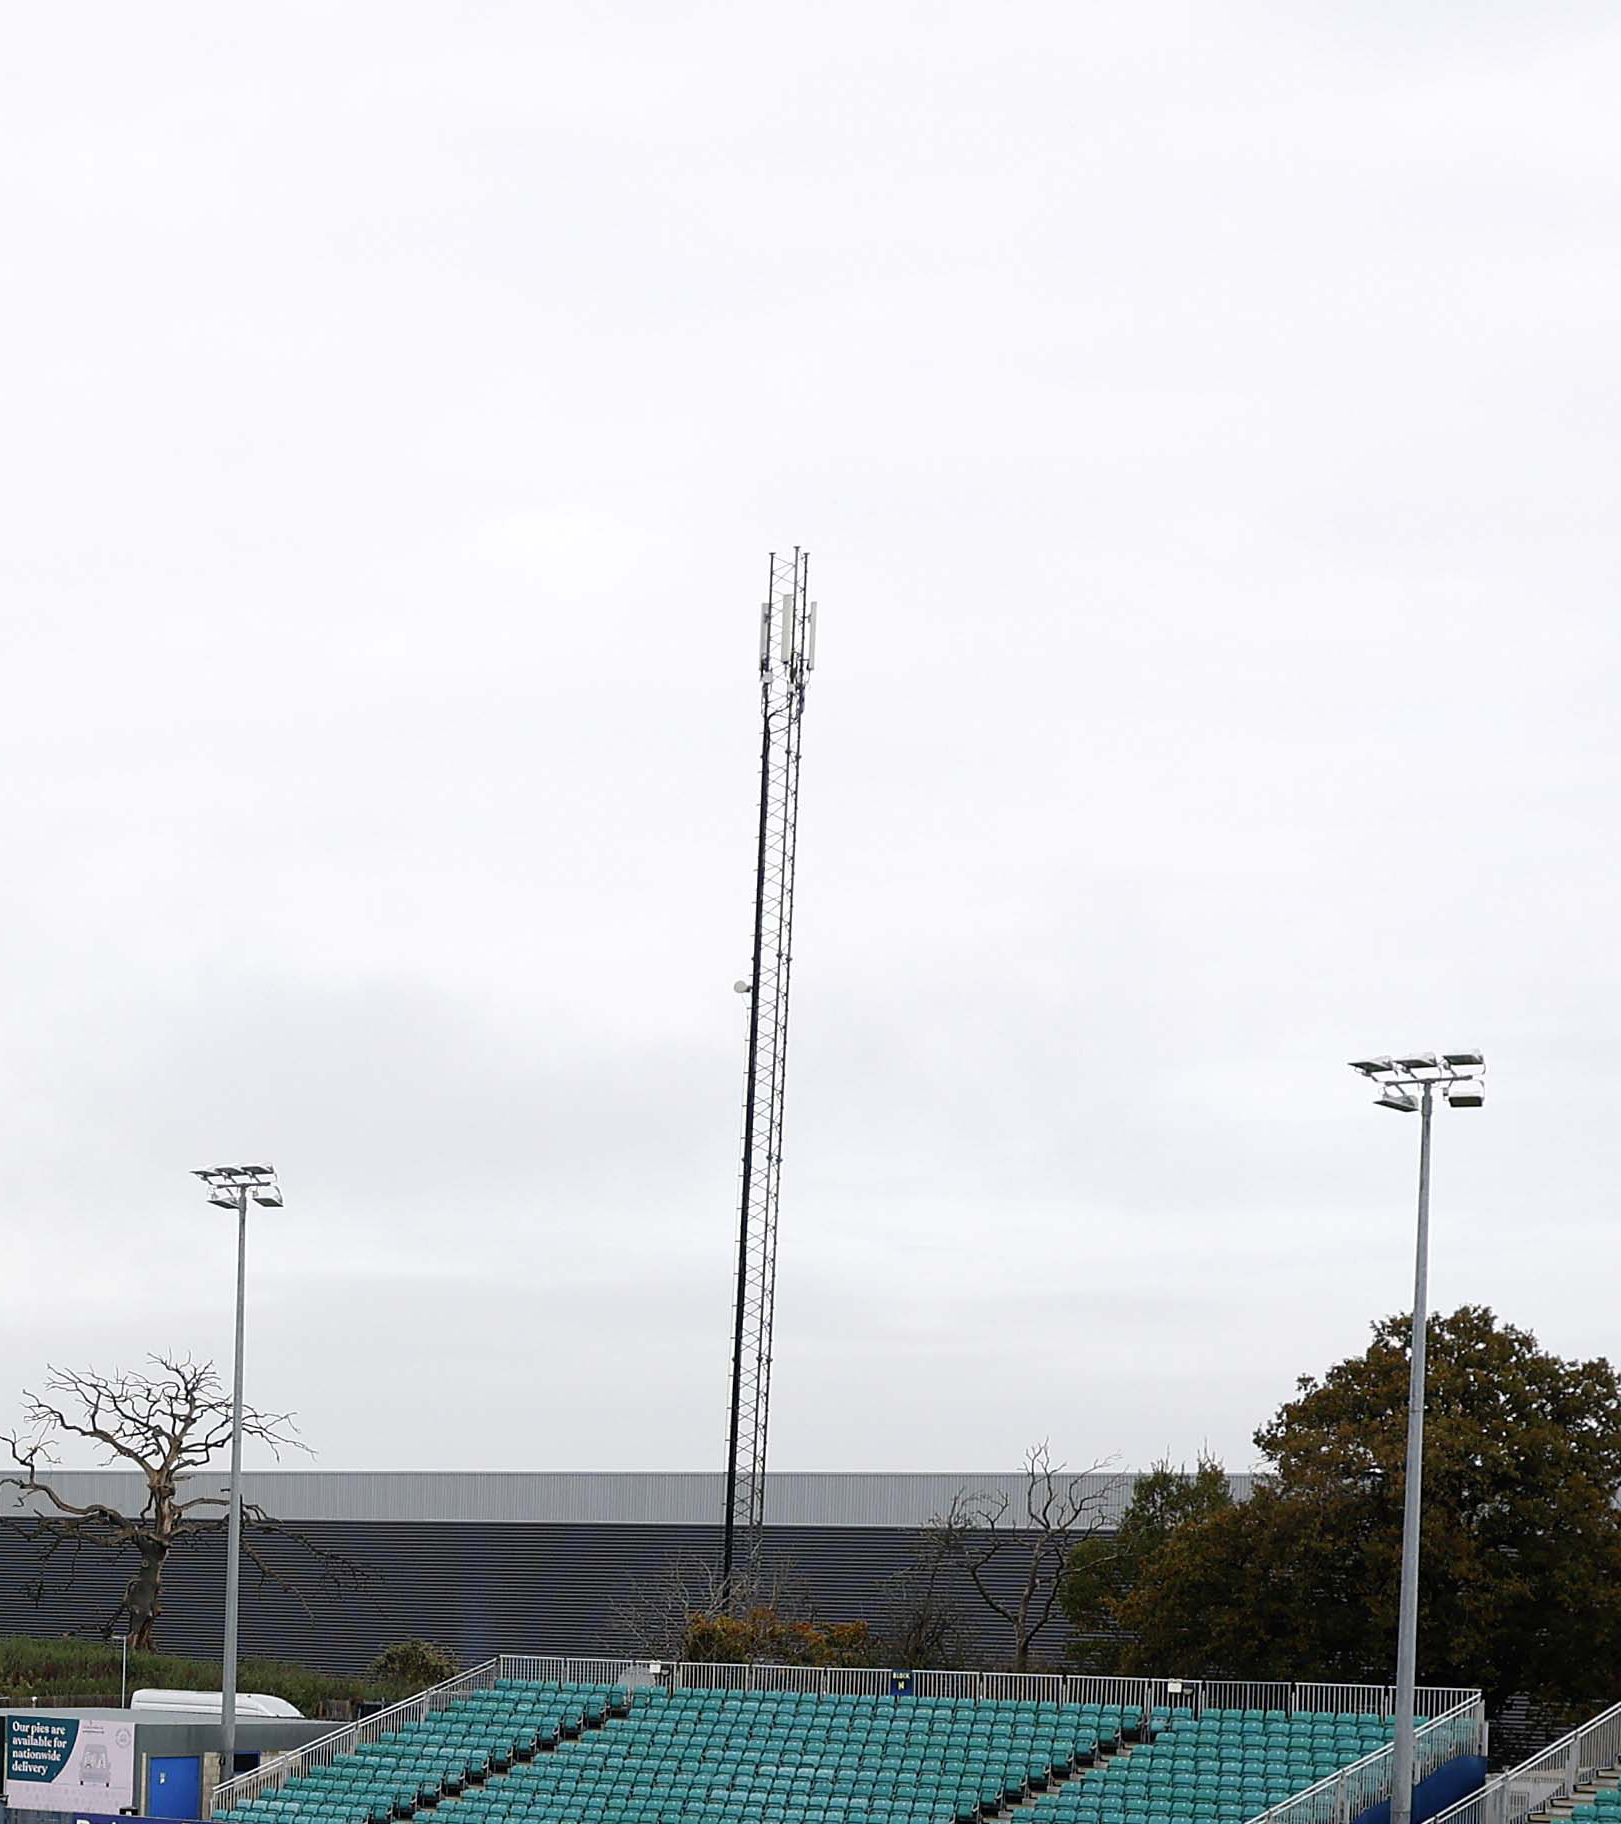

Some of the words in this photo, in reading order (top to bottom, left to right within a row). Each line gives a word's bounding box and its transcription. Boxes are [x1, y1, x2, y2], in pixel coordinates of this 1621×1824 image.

[898, 1681, 905, 1690] N
[12, 1721, 29, 1732] Our
[31, 1723, 49, 1736] pies
[51, 1726, 66, 1735] are
[12, 1734, 53, 1747] available
[53, 1738, 68, 1748] for
[12, 1749, 62, 1761] nationwide
[12, 1761, 49, 1776] delivery
